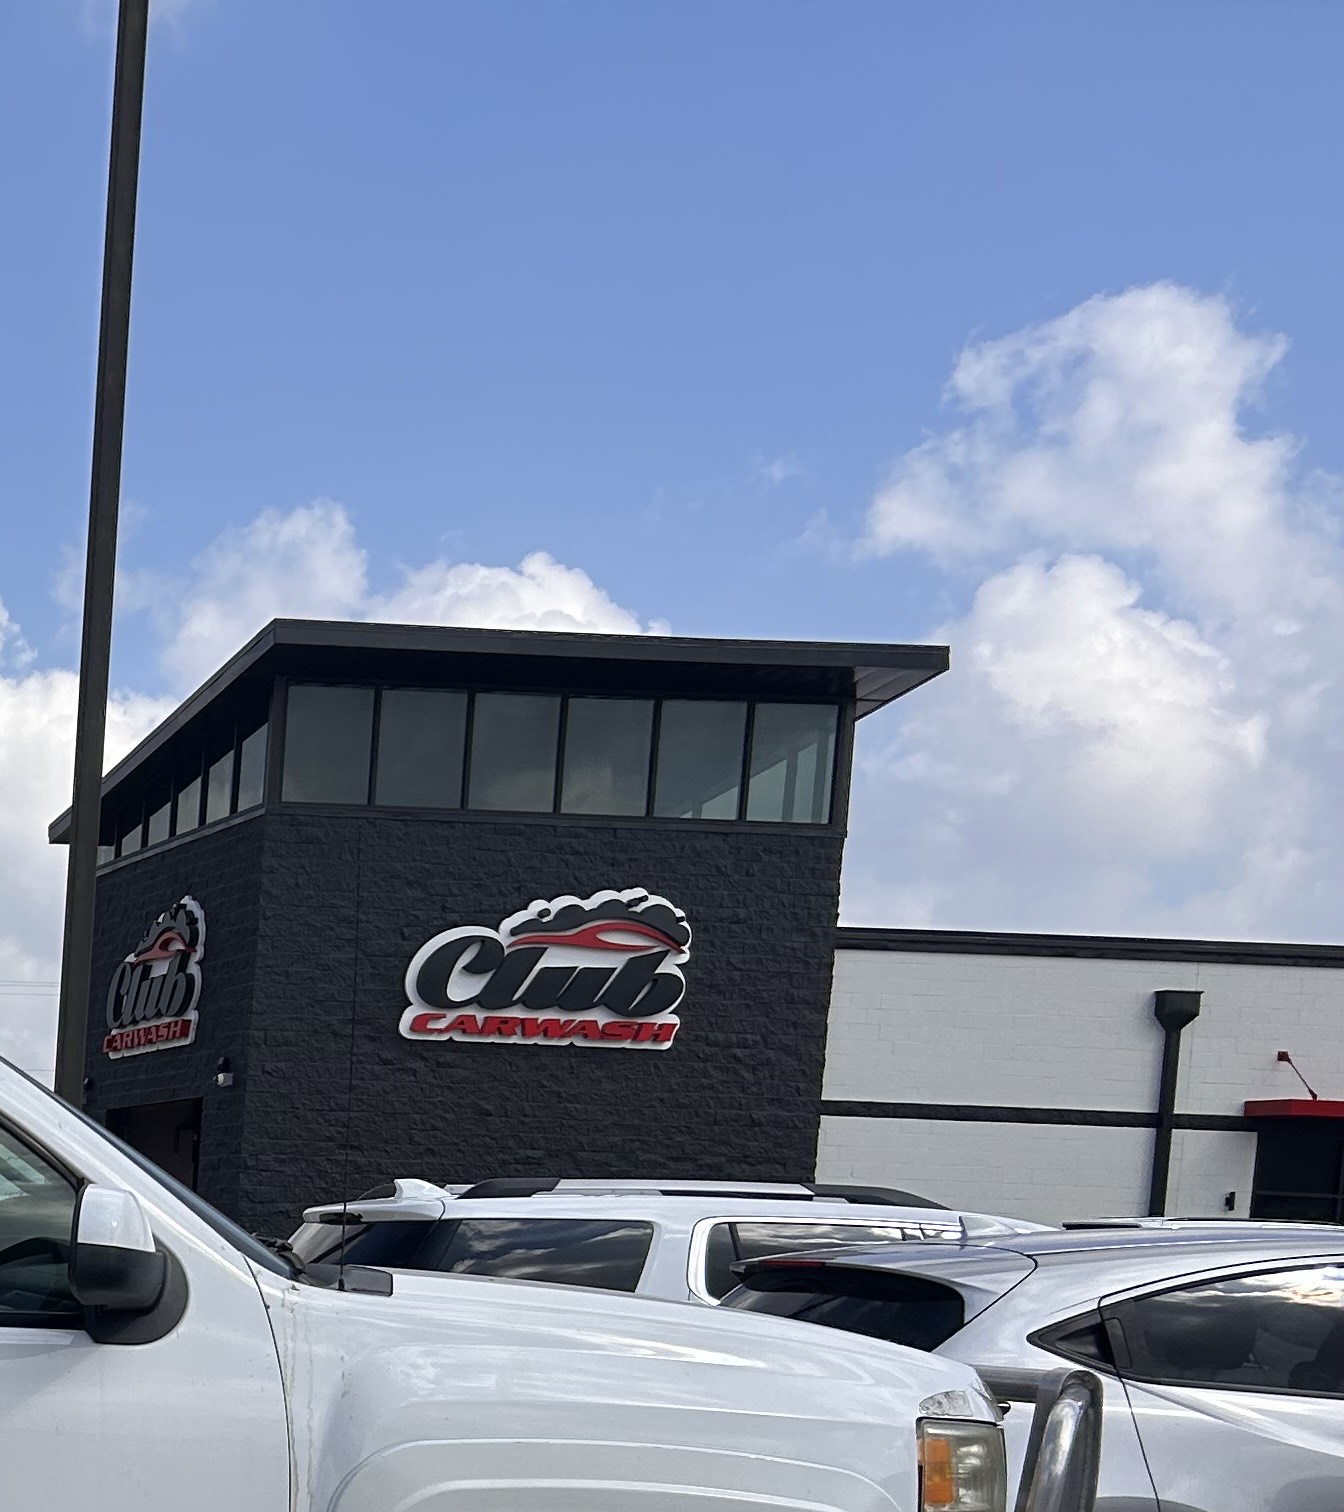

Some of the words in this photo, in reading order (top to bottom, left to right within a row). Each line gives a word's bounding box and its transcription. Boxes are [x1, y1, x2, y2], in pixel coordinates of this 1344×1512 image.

[106, 953, 192, 1029] Club
[416, 935, 686, 1016] Club
[102, 1020, 187, 1053] CARWASH
[410, 1013, 681, 1043] CARWASH
